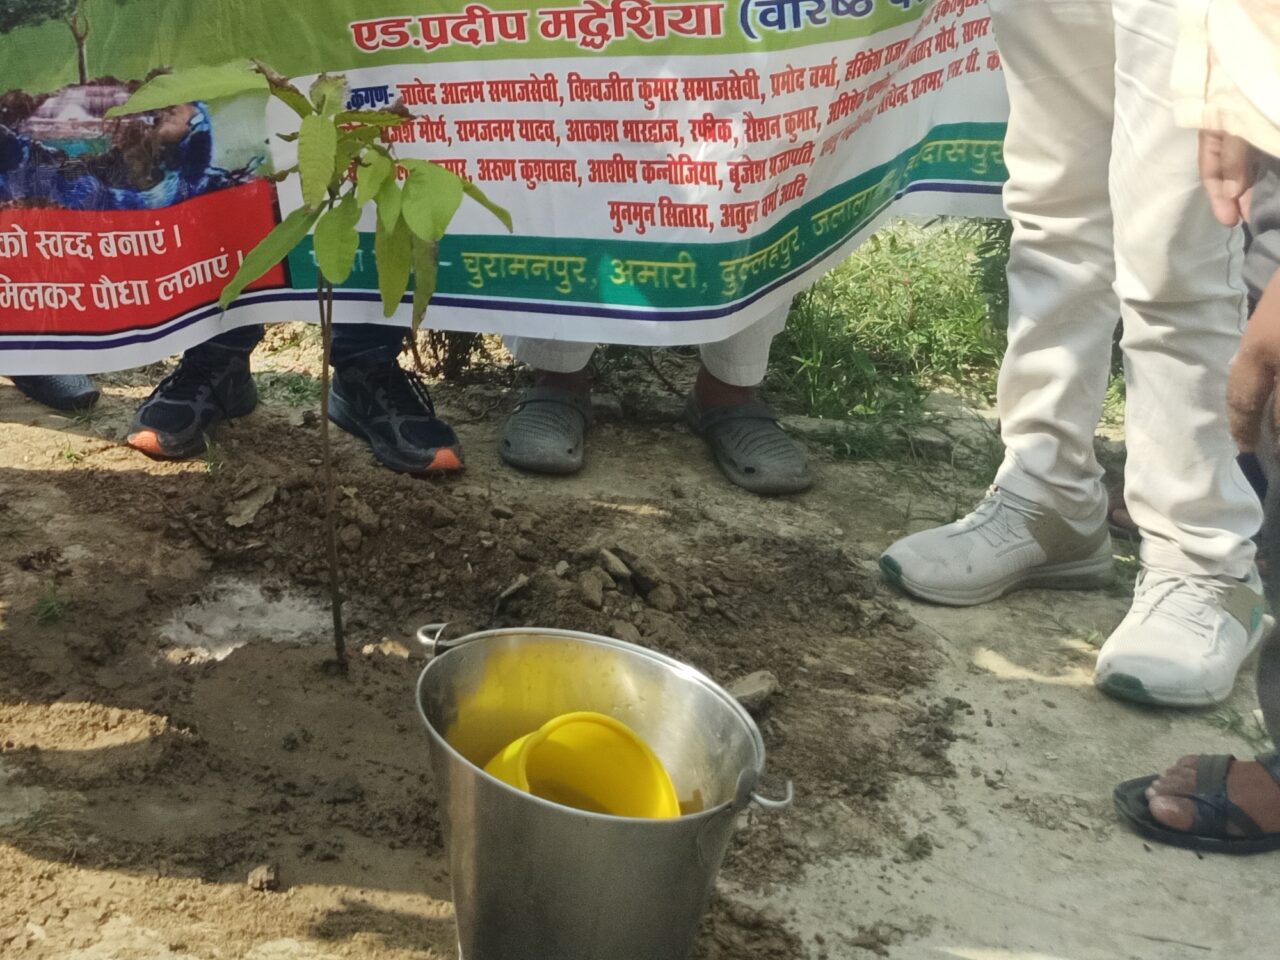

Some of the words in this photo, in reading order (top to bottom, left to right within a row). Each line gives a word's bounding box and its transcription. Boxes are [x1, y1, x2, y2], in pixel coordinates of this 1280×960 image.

[396, 78, 438, 106] जावेद
[440, 81, 485, 105] आलम
[487, 73, 564, 107] समाजसेवी,
[568, 71, 634, 102] विश्वजीत
[636, 77, 680, 111] कुमार
[681, 67, 767, 105] समाजसेवी,
[770, 63, 807, 98] प्रमोद
[809, 56, 840, 90] वर्मा,
[418, 115, 452, 146] मौर्य,
[455, 119, 516, 142] रामजनम
[517, 119, 560, 147] यादव,
[565, 119, 619, 143] आकाश
[783, 106, 821, 142] कुमार,
[519, 158, 582, 190] कुशवाहा,
[587, 153, 637, 184] आशीष
[727, 154, 767, 193] बृजेश
[607, 200, 656, 234] मुनमुन
[658, 196, 714, 232] सितारा,
[720, 200, 759, 233] अतुल
[779, 172, 808, 206] आदि
[34, 230, 94, 260] स्वच्छ
[91, 274, 151, 310] पौधा
